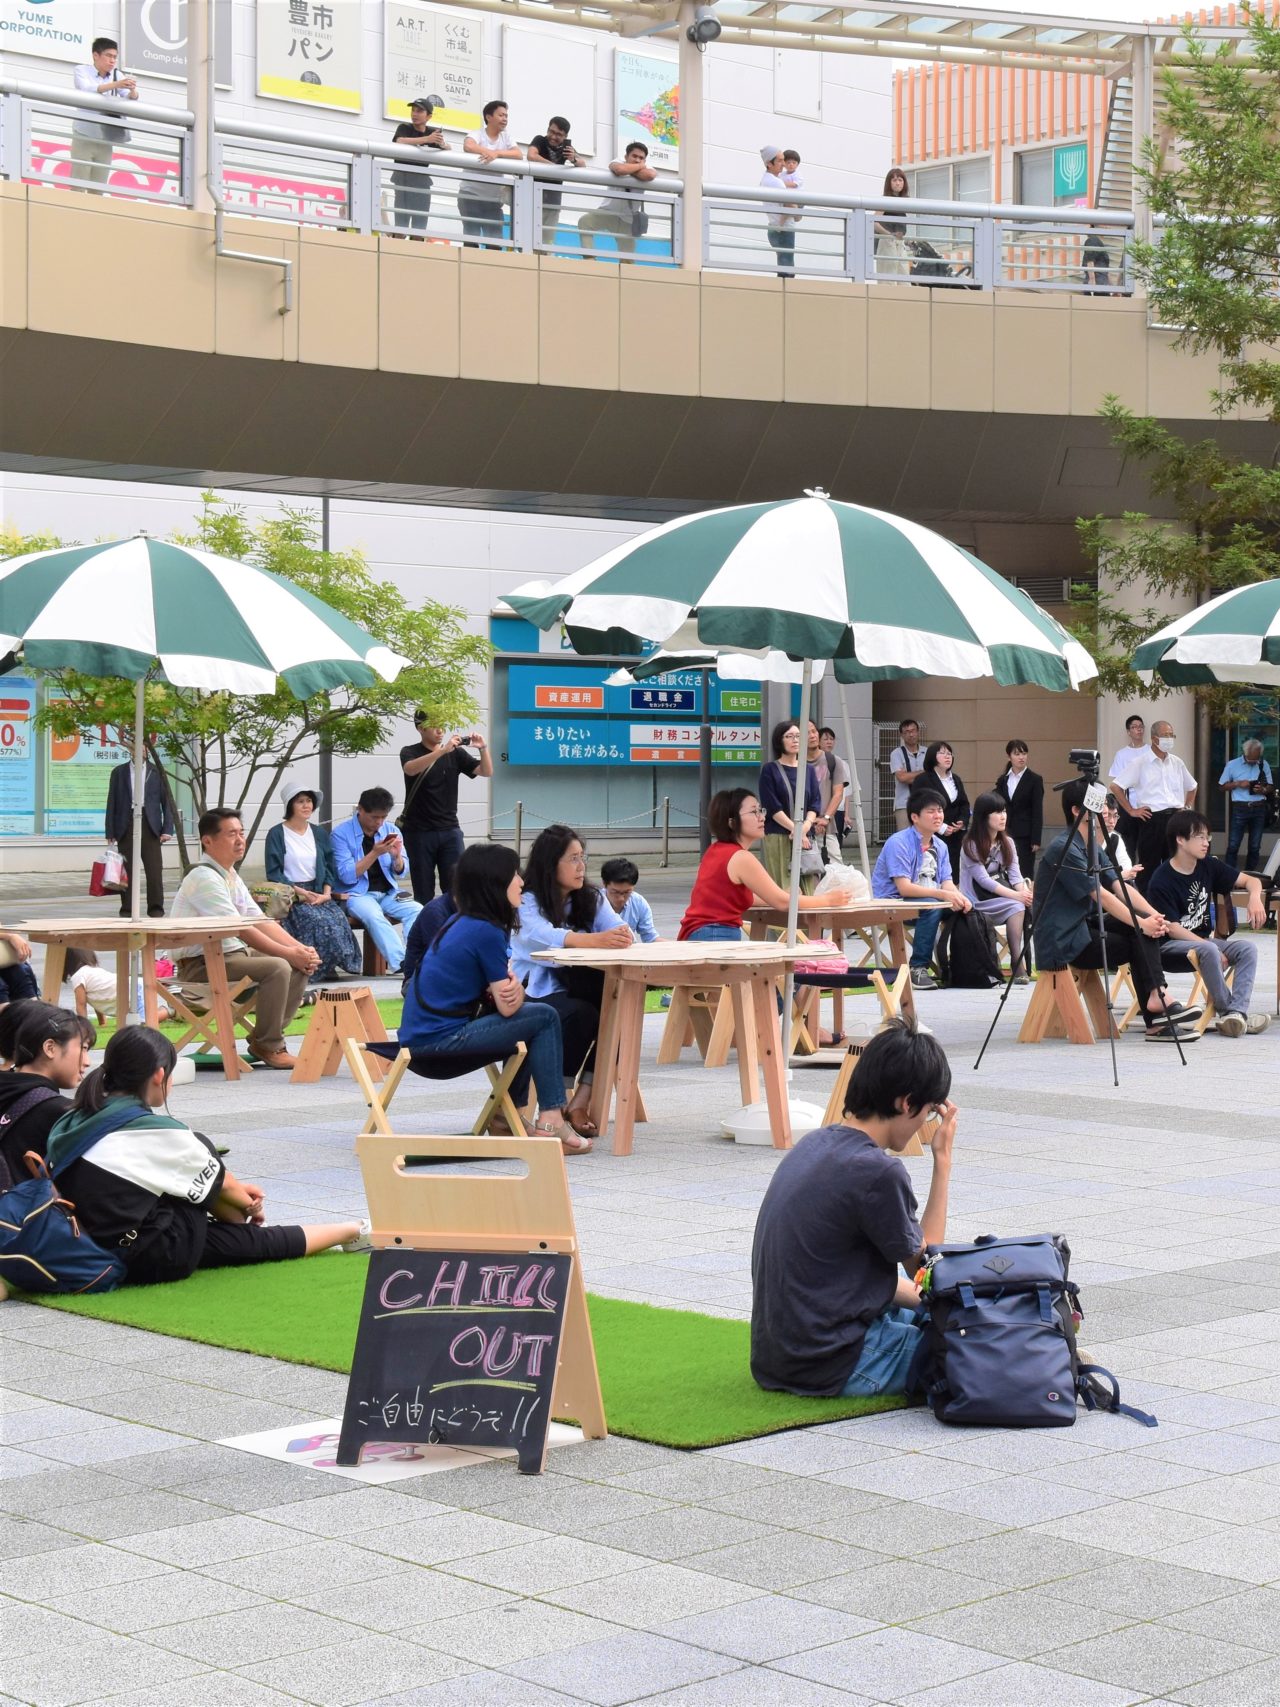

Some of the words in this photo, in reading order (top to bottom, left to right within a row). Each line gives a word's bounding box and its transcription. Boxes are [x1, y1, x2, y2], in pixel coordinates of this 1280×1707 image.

[17, 10, 54, 26] YUME
[396, 16, 428, 33] A.R.T.
[444, 23, 470, 39] くくむ
[143, 50, 171, 63] Champ
[287, 37, 334, 62] パン
[442, 72, 474, 86] GELATO
[445, 84, 472, 97] SANTA
[547, 691, 592, 704] 資産運用
[643, 691, 683, 703] 退職金
[534, 726, 591, 741] まもりたい
[558, 743, 625, 759] 資産がある。
[651, 750, 685, 760] 遺言
[449, 1325, 554, 1378] OUT
